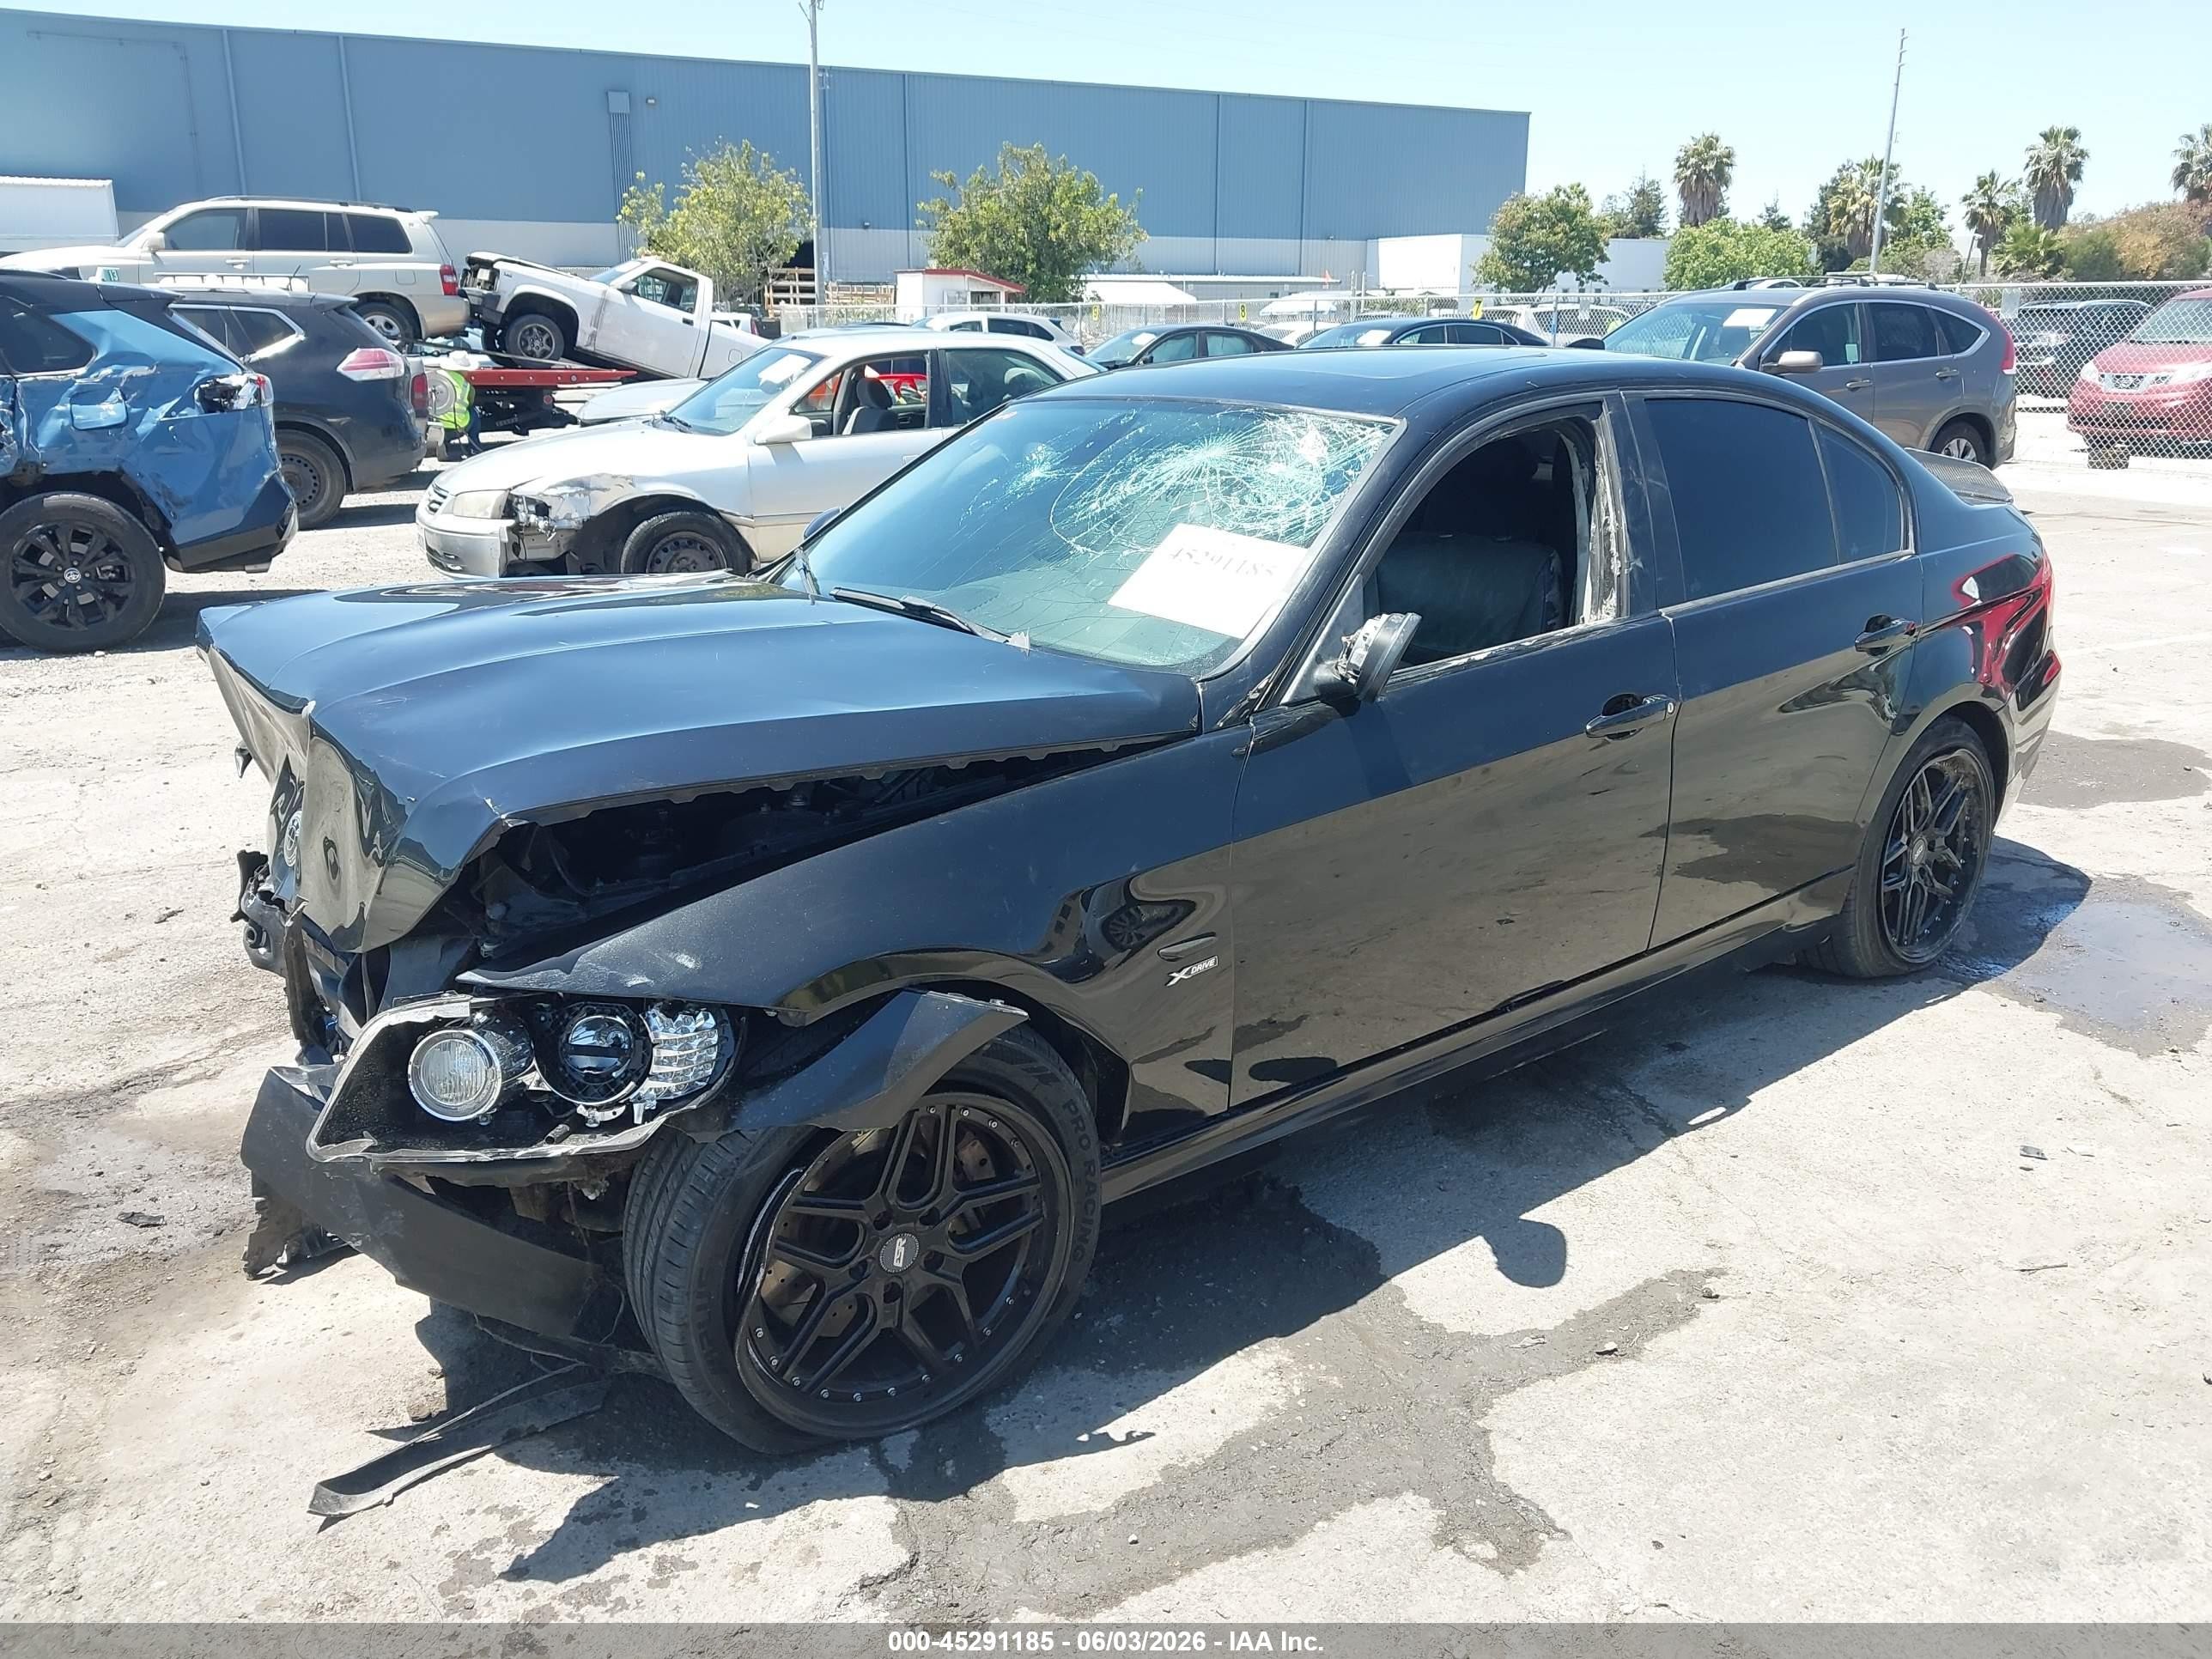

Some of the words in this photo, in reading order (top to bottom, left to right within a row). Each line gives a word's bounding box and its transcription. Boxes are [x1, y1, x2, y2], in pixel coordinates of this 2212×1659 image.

[1240, 304, 1246, 318] 8
[1475, 301, 1482, 316] 7
[1062, 1098, 1091, 1152] PRO
[1073, 1160, 1097, 1263] RACING
[893, 1237, 907, 1268] ESR
